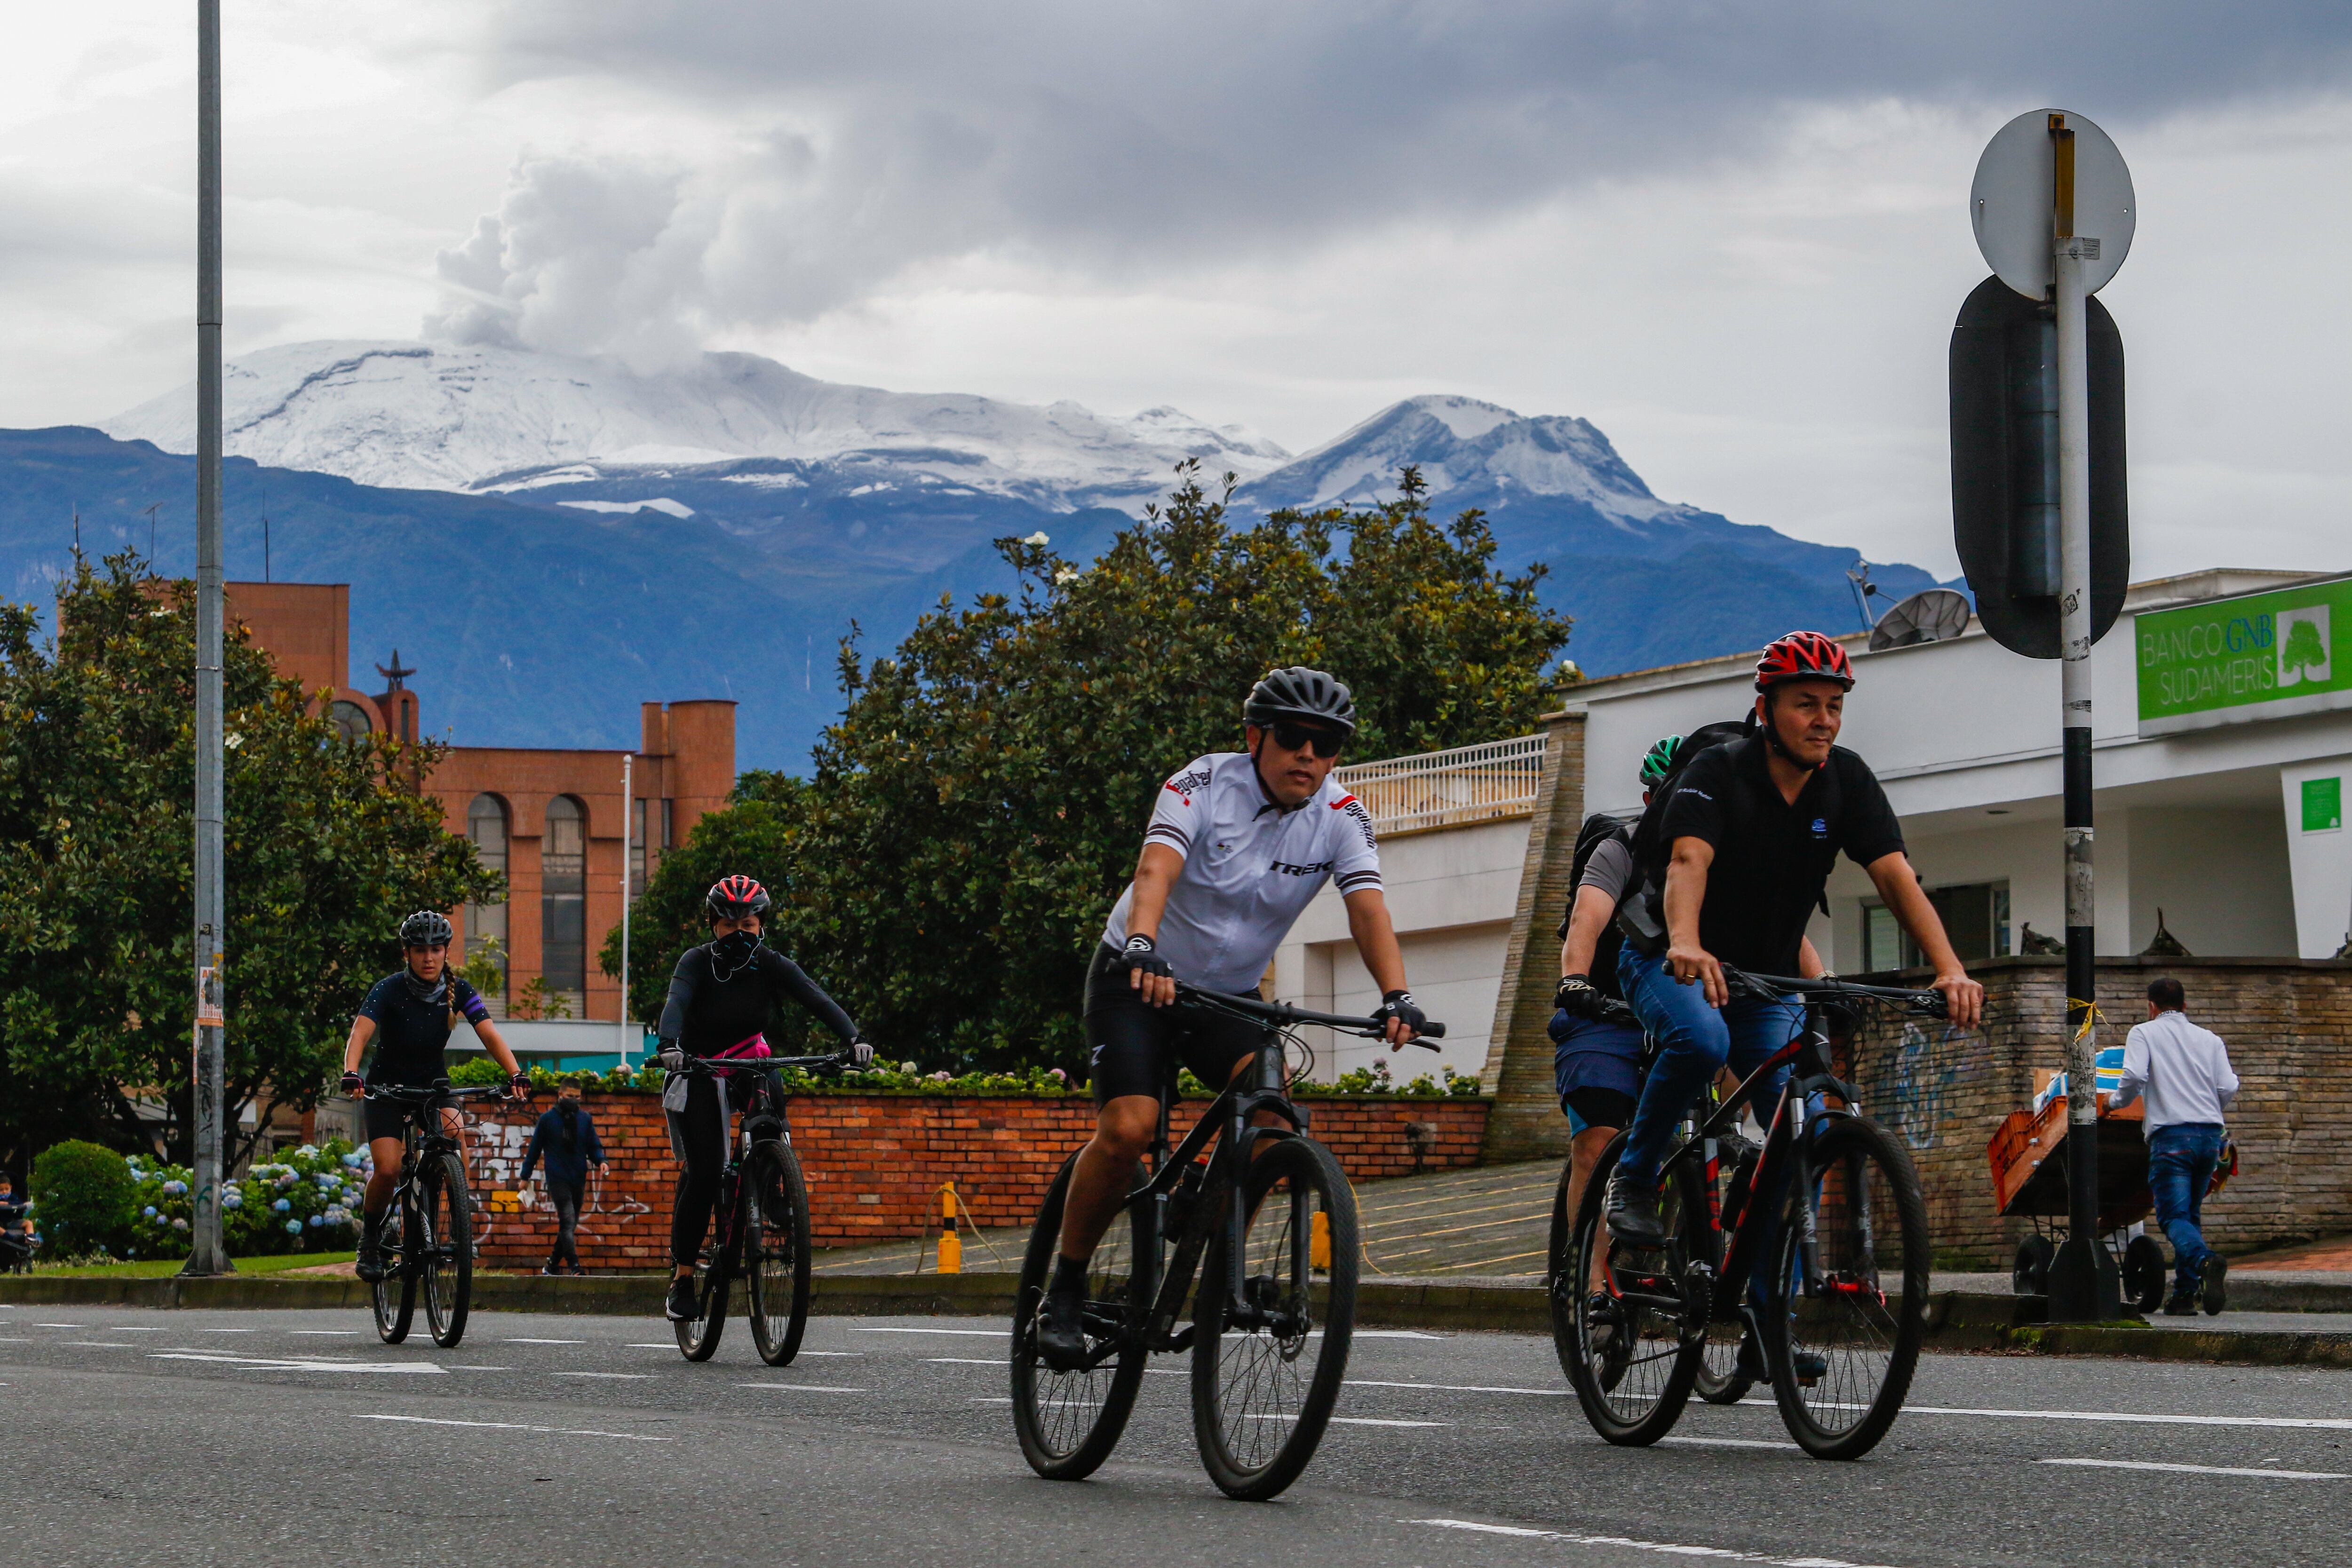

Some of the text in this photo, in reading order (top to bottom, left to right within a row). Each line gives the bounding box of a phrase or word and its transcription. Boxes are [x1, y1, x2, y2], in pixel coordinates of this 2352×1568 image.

[2143, 614, 2273, 667] BANCO GNB
[2160, 655, 2274, 705] SUDAMERIS
[1269, 860, 1334, 876] TREK
